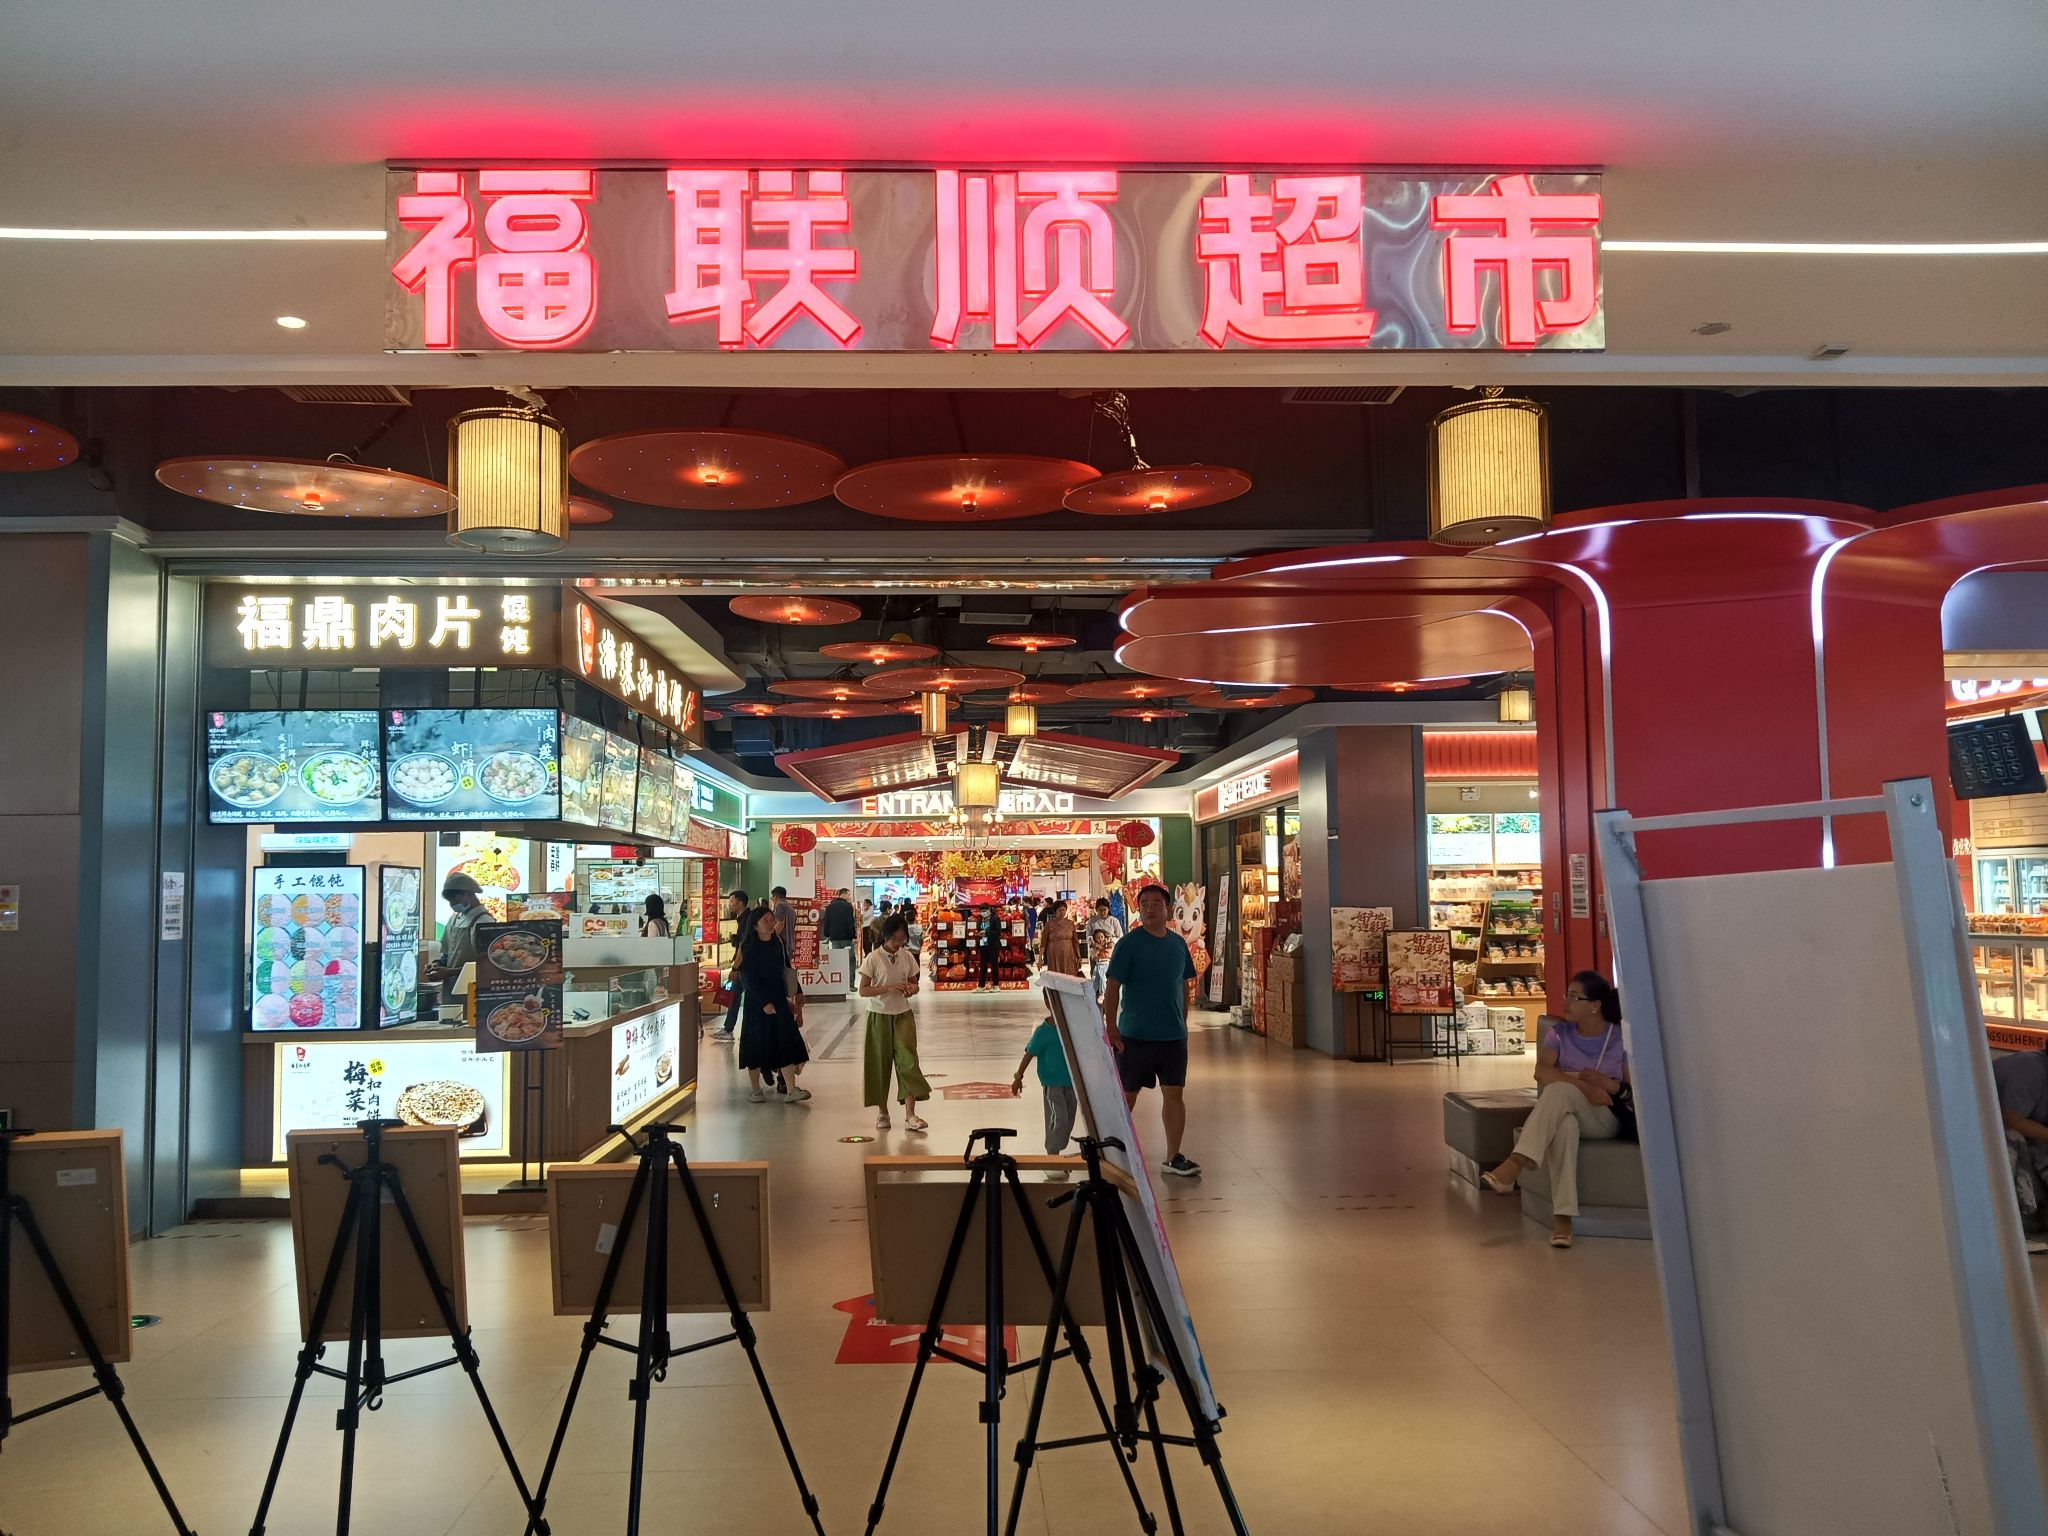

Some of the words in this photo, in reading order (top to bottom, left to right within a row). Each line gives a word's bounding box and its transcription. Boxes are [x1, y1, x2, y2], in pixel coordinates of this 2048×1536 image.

[395, 168, 1602, 350] 福联顺超市
[236, 595, 481, 650] 福鼎肉片
[500, 593, 530, 655] 馄饨
[273, 874, 345, 889] 手工馄饨
[798, 970, 842, 985] 市入口
[343, 1060, 369, 1112] 梅菜
